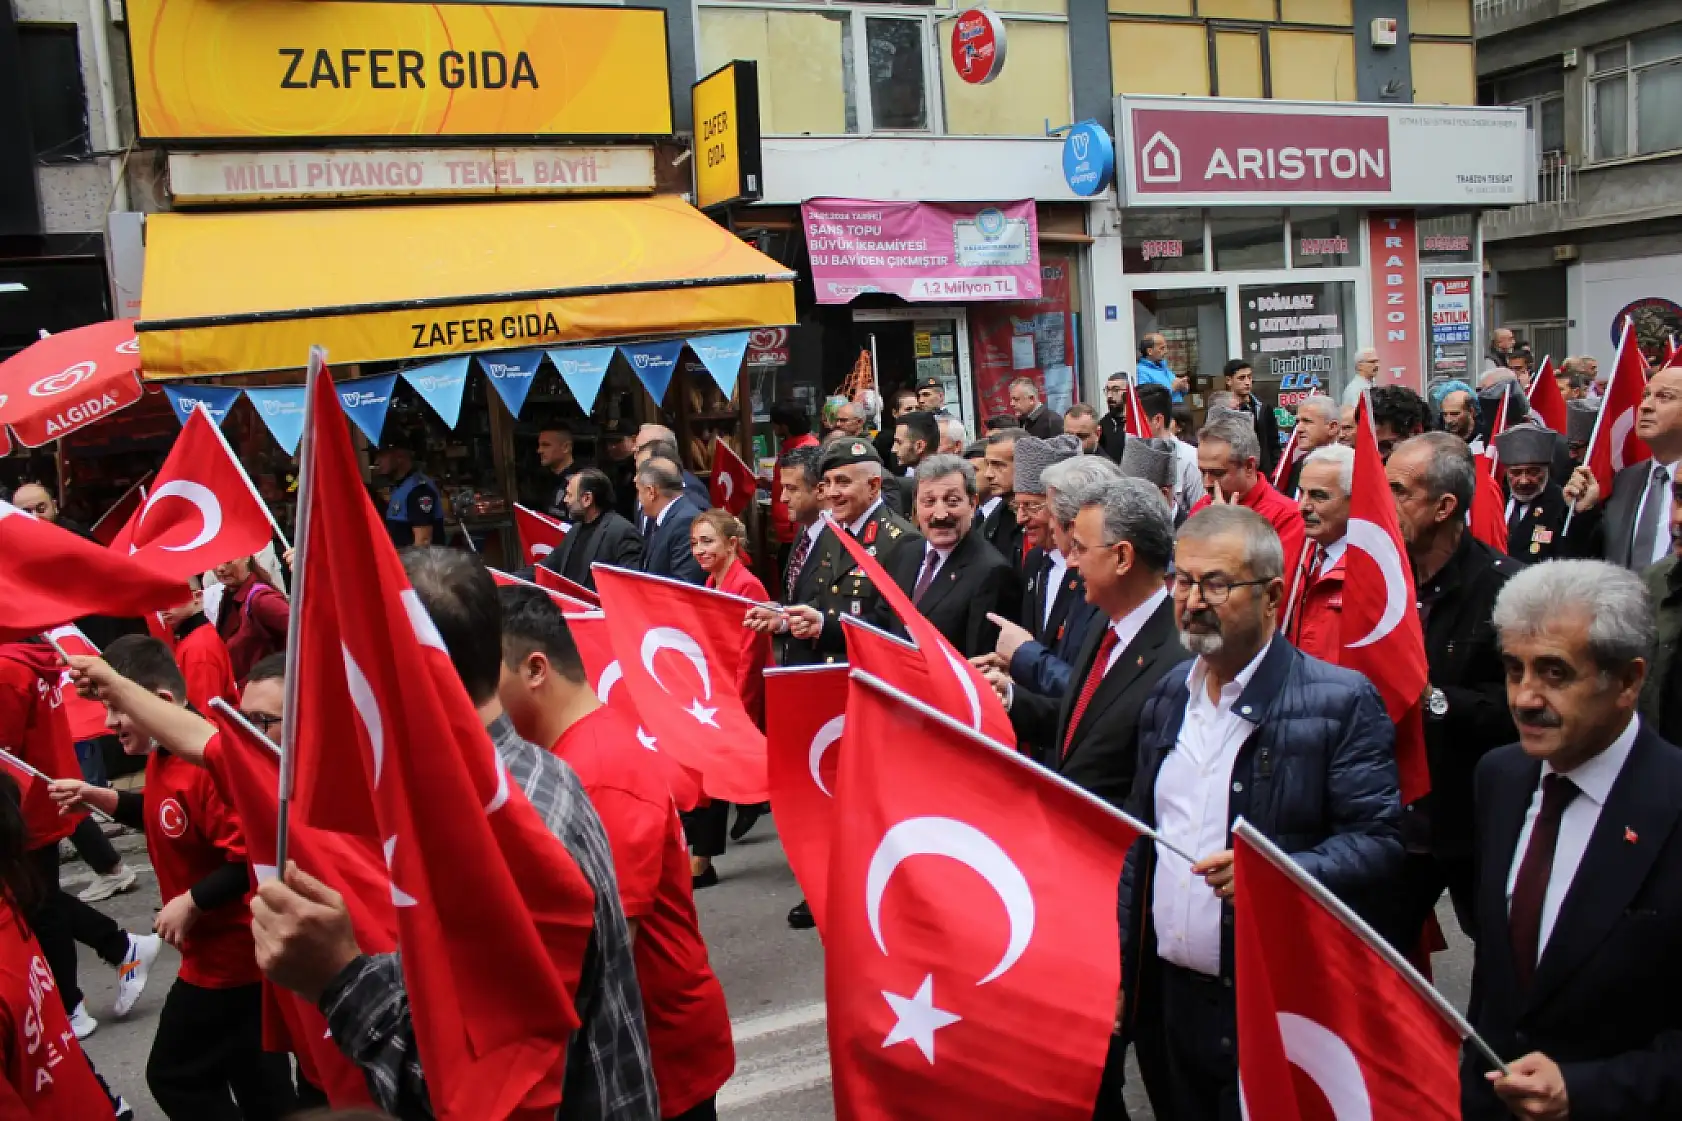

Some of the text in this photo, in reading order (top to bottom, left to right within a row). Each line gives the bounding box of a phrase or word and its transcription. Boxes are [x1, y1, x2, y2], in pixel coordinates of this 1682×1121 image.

[277, 48, 539, 90] ZAFER GIDA
[703, 110, 728, 141] ZAFER
[707, 142, 727, 168] GIDA
[1203, 146, 1386, 179] ARISTON
[444, 159, 523, 185] TEKEL
[810, 222, 882, 237] ŞANS TOPU
[810, 236, 928, 251] BÜYÜK İKRAMİYESİ
[1142, 239, 1183, 261] ŞOFBEN
[811, 251, 949, 269] BU BAYİDEN ÇIKMIŞTIR
[944, 280, 992, 298] Milyon
[994, 279, 1013, 292] TL
[1384, 218, 1405, 343] TRABZON
[411, 311, 560, 349] ZAFER GIDA
[1432, 310, 1469, 325] SATILIK
